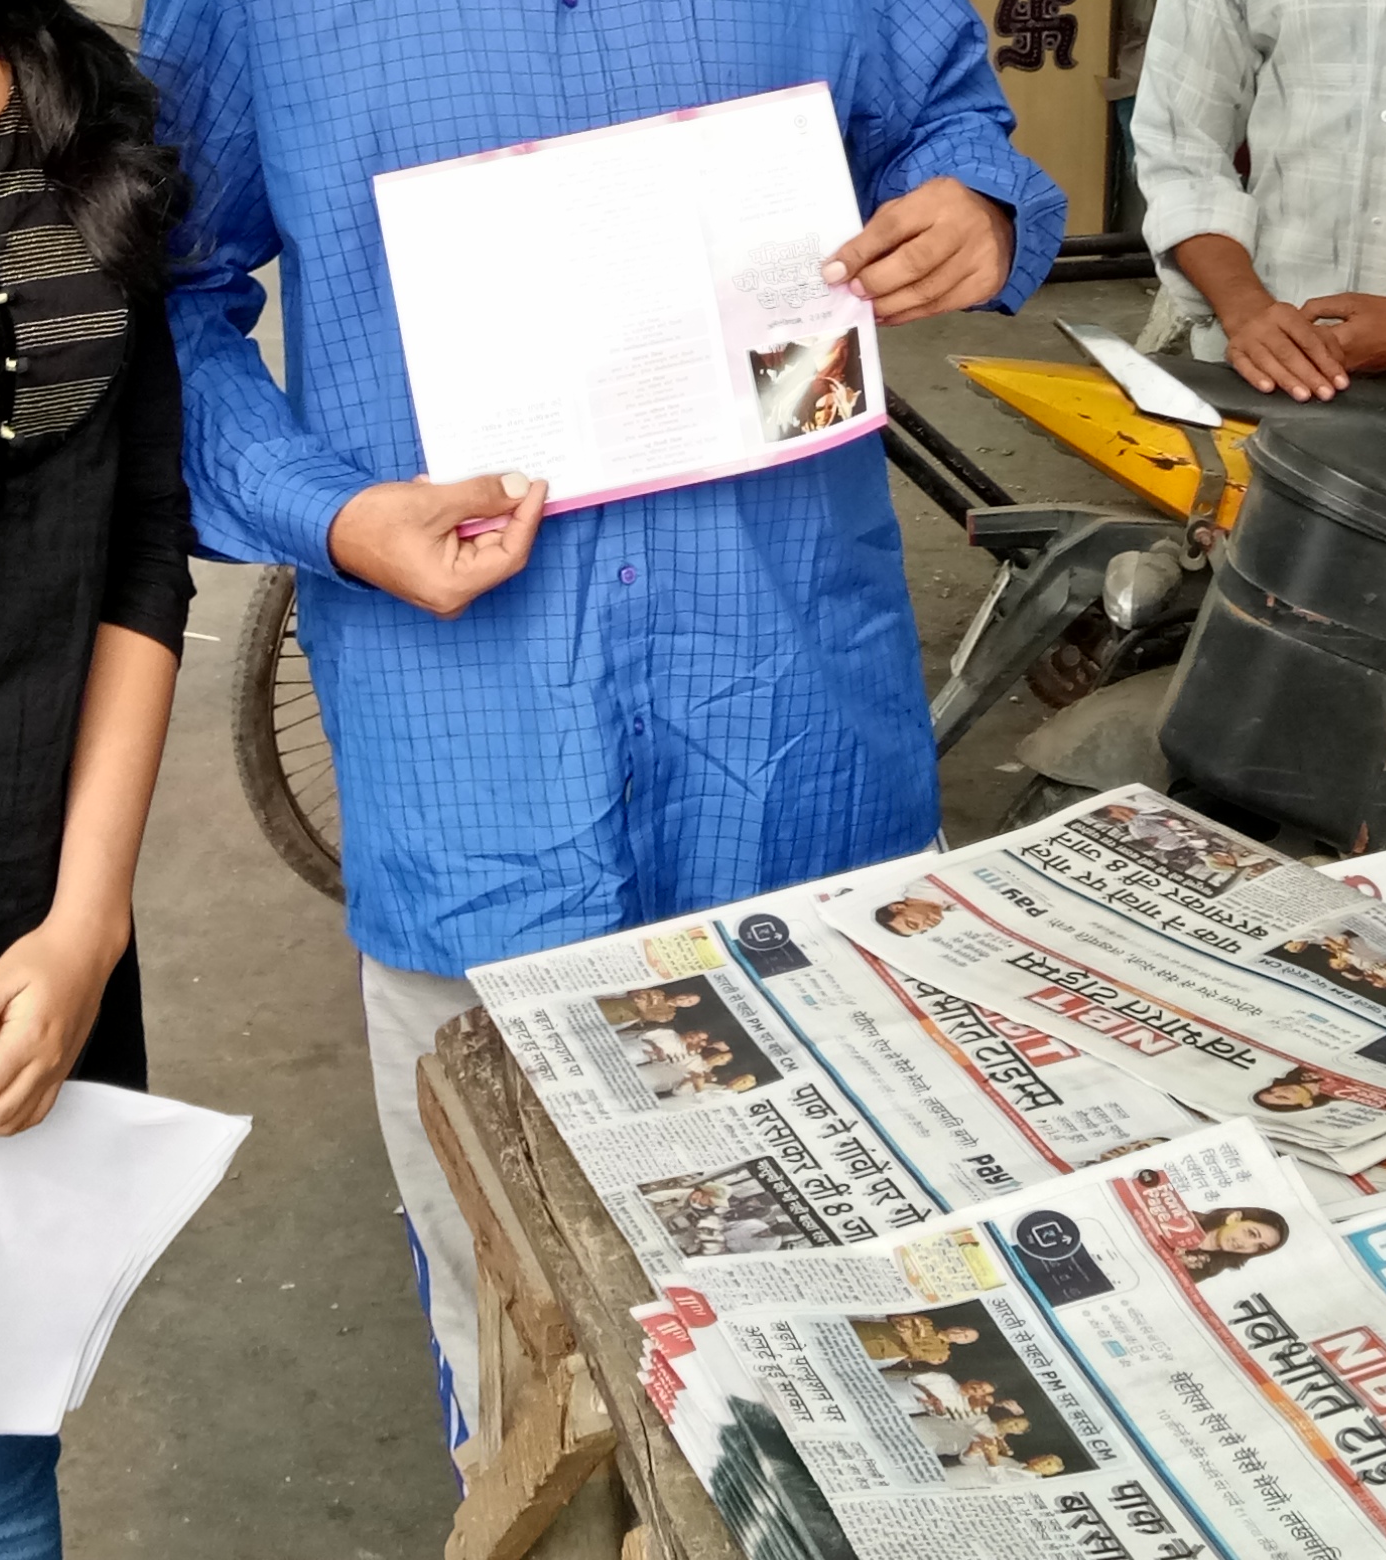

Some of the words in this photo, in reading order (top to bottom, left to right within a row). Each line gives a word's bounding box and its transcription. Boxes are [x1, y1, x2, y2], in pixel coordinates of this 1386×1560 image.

[1073, 871, 1107, 892] पर
[1109, 858, 1126, 872] 8
[972, 867, 1048, 918] Paytm
[1108, 887, 1168, 920] गांवों
[1168, 888, 1270, 939] बरसाकर
[1158, 915, 1187, 933] ने
[1186, 926, 1242, 955] पाक
[1006, 951, 1114, 1008] टाइम्स
[1258, 956, 1281, 974] CM
[1329, 986, 1352, 1003] PM
[904, 974, 999, 1045] वभारत
[975, 1040, 1064, 1113] टाइम्स
[983, 1007, 1076, 1065] BT
[1028, 989, 1175, 1055] NBT
[1114, 1001, 1258, 1070] नवभारत
[748, 1018, 765, 1033] PM
[779, 1056, 800, 1073] CM
[790, 1081, 838, 1122] पाक
[822, 1117, 859, 1142] ने
[745, 1098, 822, 1175] बरसाकर
[822, 1202, 854, 1218] 8
[833, 1137, 894, 1184] गांवों
[869, 1177, 907, 1210] पर
[1142, 1186, 1171, 1224] Page
[1158, 1183, 1189, 1217] Front
[1161, 1216, 1196, 1239] 2
[1230, 1293, 1362, 1419] नवभारत
[1039, 1368, 1064, 1392] PM
[1086, 1437, 1117, 1461] CM
[1106, 1480, 1178, 1537] पाक
